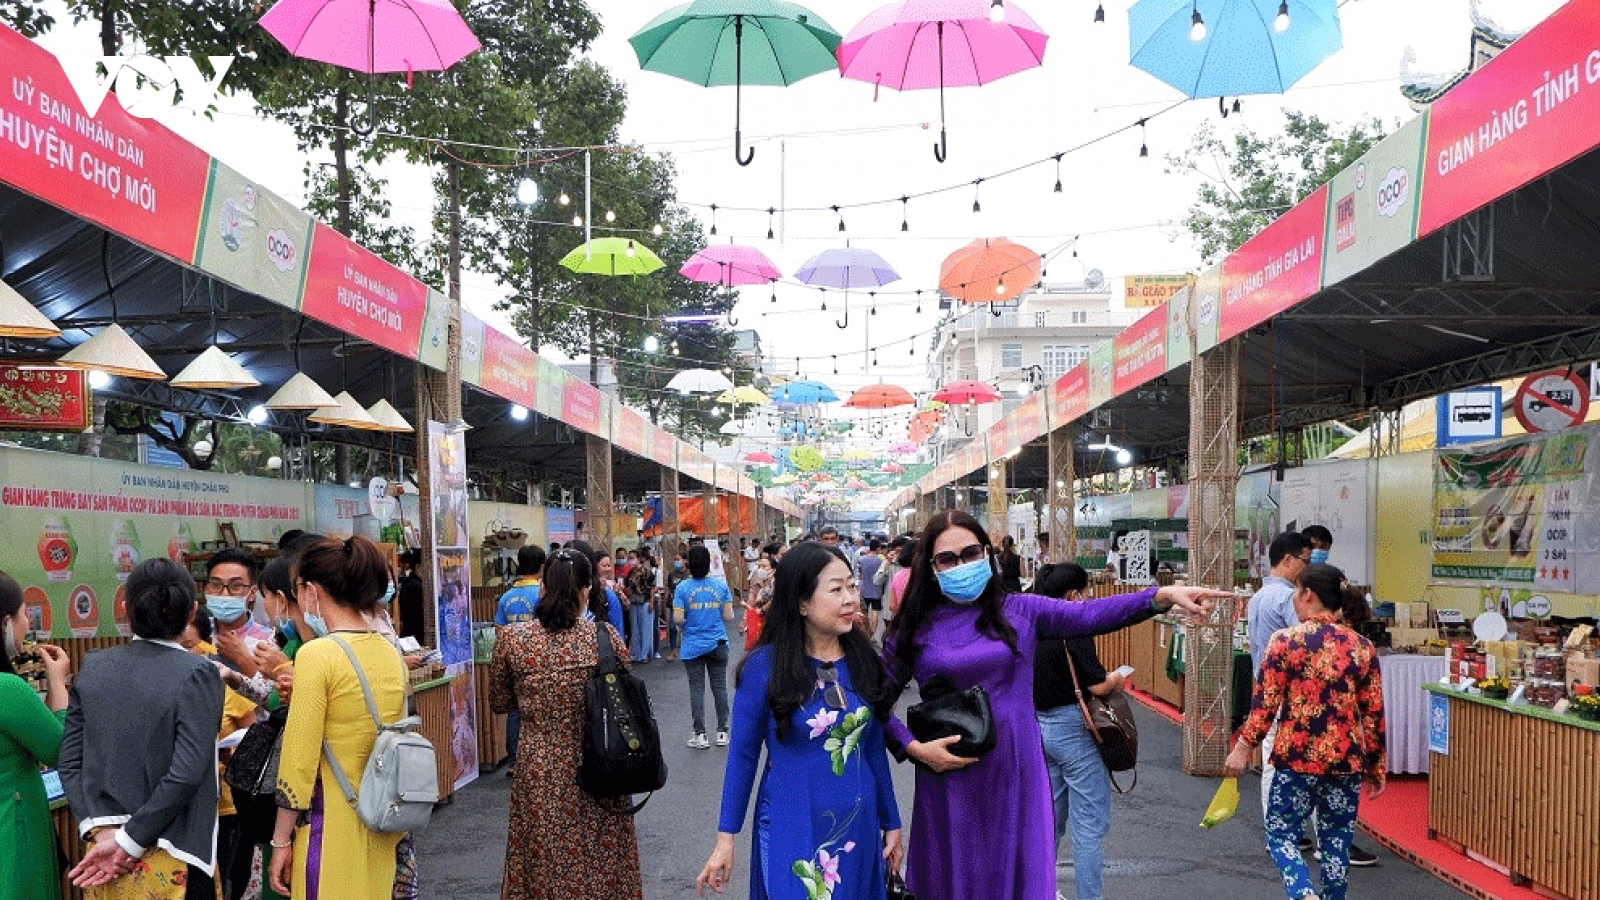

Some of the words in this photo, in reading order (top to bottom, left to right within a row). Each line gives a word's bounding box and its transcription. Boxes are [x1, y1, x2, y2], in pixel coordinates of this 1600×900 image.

[12, 75, 35, 106] UỶ
[39, 91, 71, 128] BAN
[75, 112, 115, 151] NHÂN
[117, 136, 144, 169] DÂN
[1437, 132, 1475, 177] GIAN
[1478, 99, 1528, 153] HÀNG
[1532, 62, 1580, 118] TỈNH
[0, 107, 74, 172] HUYỆN
[79, 151, 121, 200] CHỢ
[125, 174, 157, 214] MỚI
[1378, 175, 1407, 208] OCOP
[267, 235, 296, 257] OCOP
[353, 271, 368, 290] BAN
[1226, 282, 1243, 306] GIAN
[1243, 270, 1263, 295] HÀNG
[1264, 256, 1283, 284] TỈNH
[1300, 235, 1315, 263] LAI
[337, 285, 368, 316] HUYỆN
[369, 301, 388, 328] CHỢ
[388, 310, 402, 332] MỚI
[132, 474, 147, 487] BAN
[2, 486, 24, 506] GIAN
[25, 484, 49, 508] HÀNG
[50, 488, 77, 510] TRƯNG
[77, 489, 93, 511] BÀY
[129, 497, 147, 514] OCOP
[1546, 528, 1567, 541] OCOP
